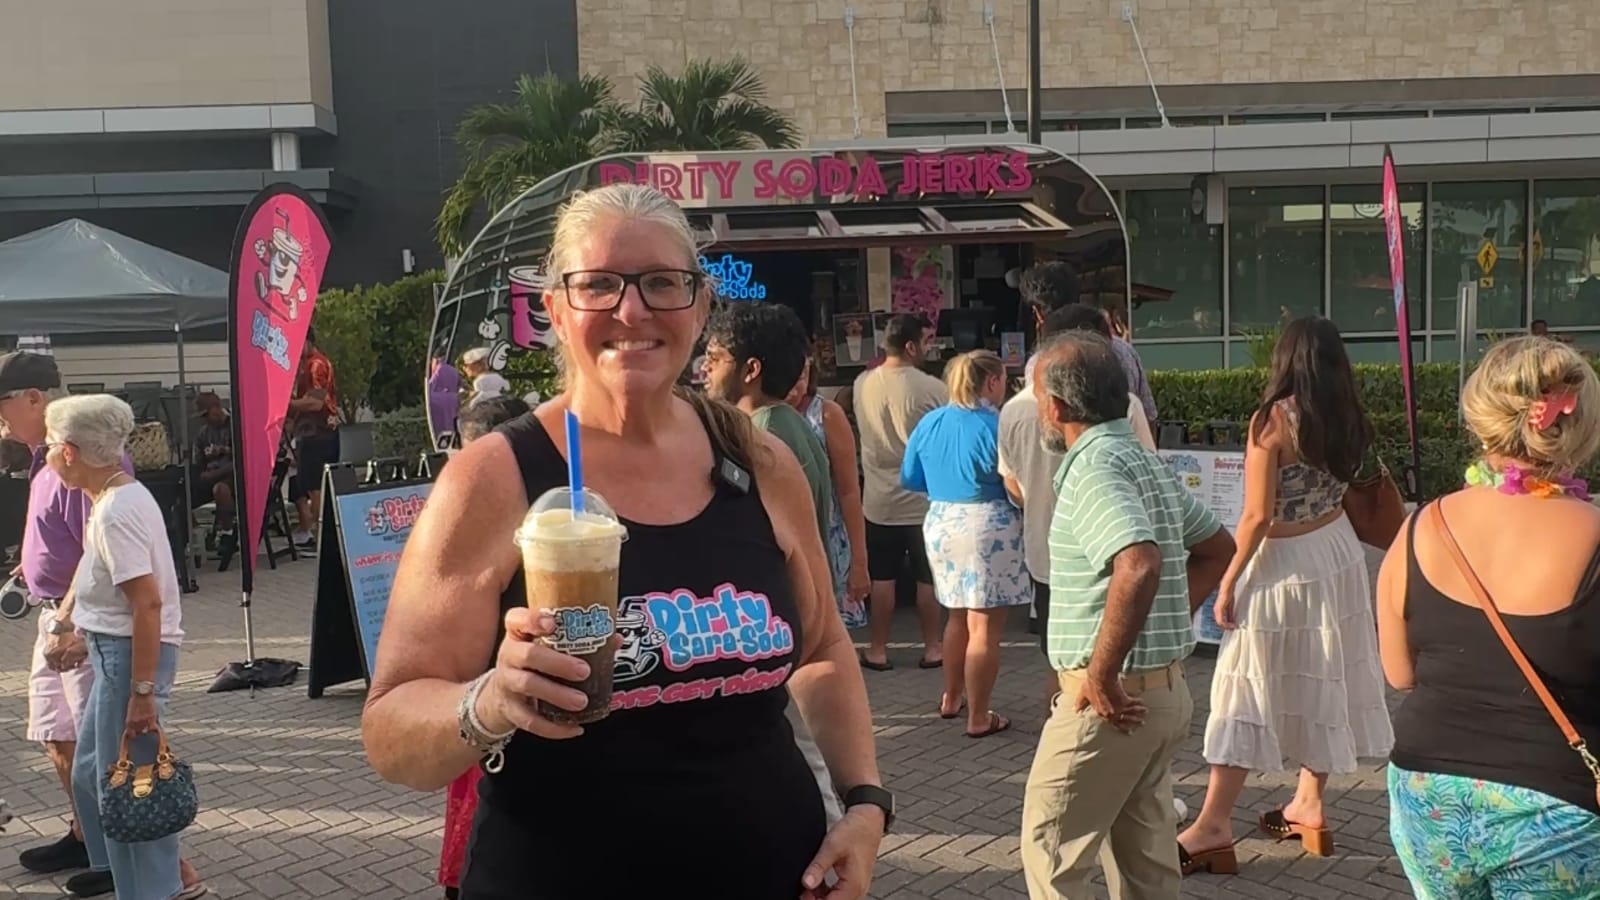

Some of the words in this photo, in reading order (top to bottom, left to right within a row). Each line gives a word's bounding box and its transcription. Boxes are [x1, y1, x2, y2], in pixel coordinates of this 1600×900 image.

[598, 160, 741, 200] DIRTY
[753, 155, 888, 198] SODA
[897, 152, 1033, 195] JERKS
[648, 587, 768, 636] Dirty
[669, 624, 791, 667] Sara-Soda
[661, 678, 724, 704] GET
